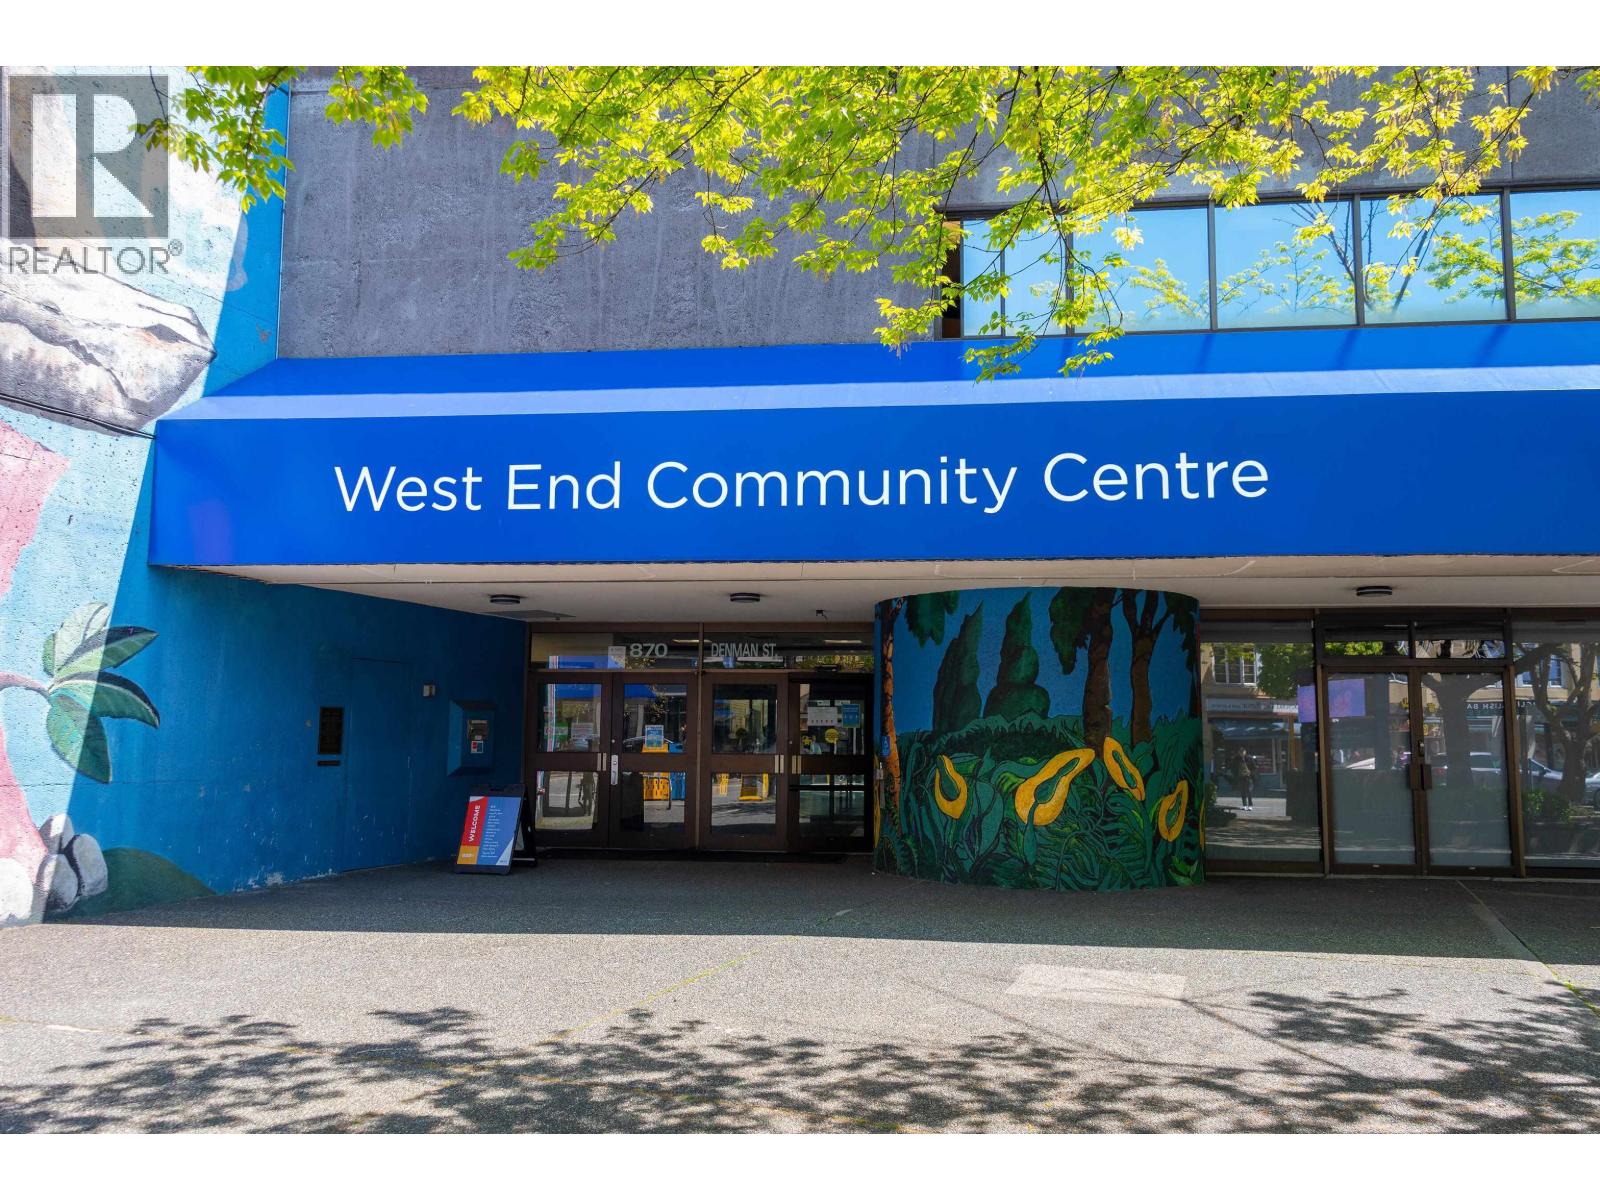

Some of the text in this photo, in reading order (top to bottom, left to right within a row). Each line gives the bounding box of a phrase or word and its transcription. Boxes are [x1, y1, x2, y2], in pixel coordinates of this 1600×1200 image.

[334, 451, 1269, 514] West End Community Centre
[629, 643, 668, 658] 870
[711, 643, 759, 657] DENMAN
[762, 643, 779, 658] ST.
[468, 805, 481, 842] WELCOME
